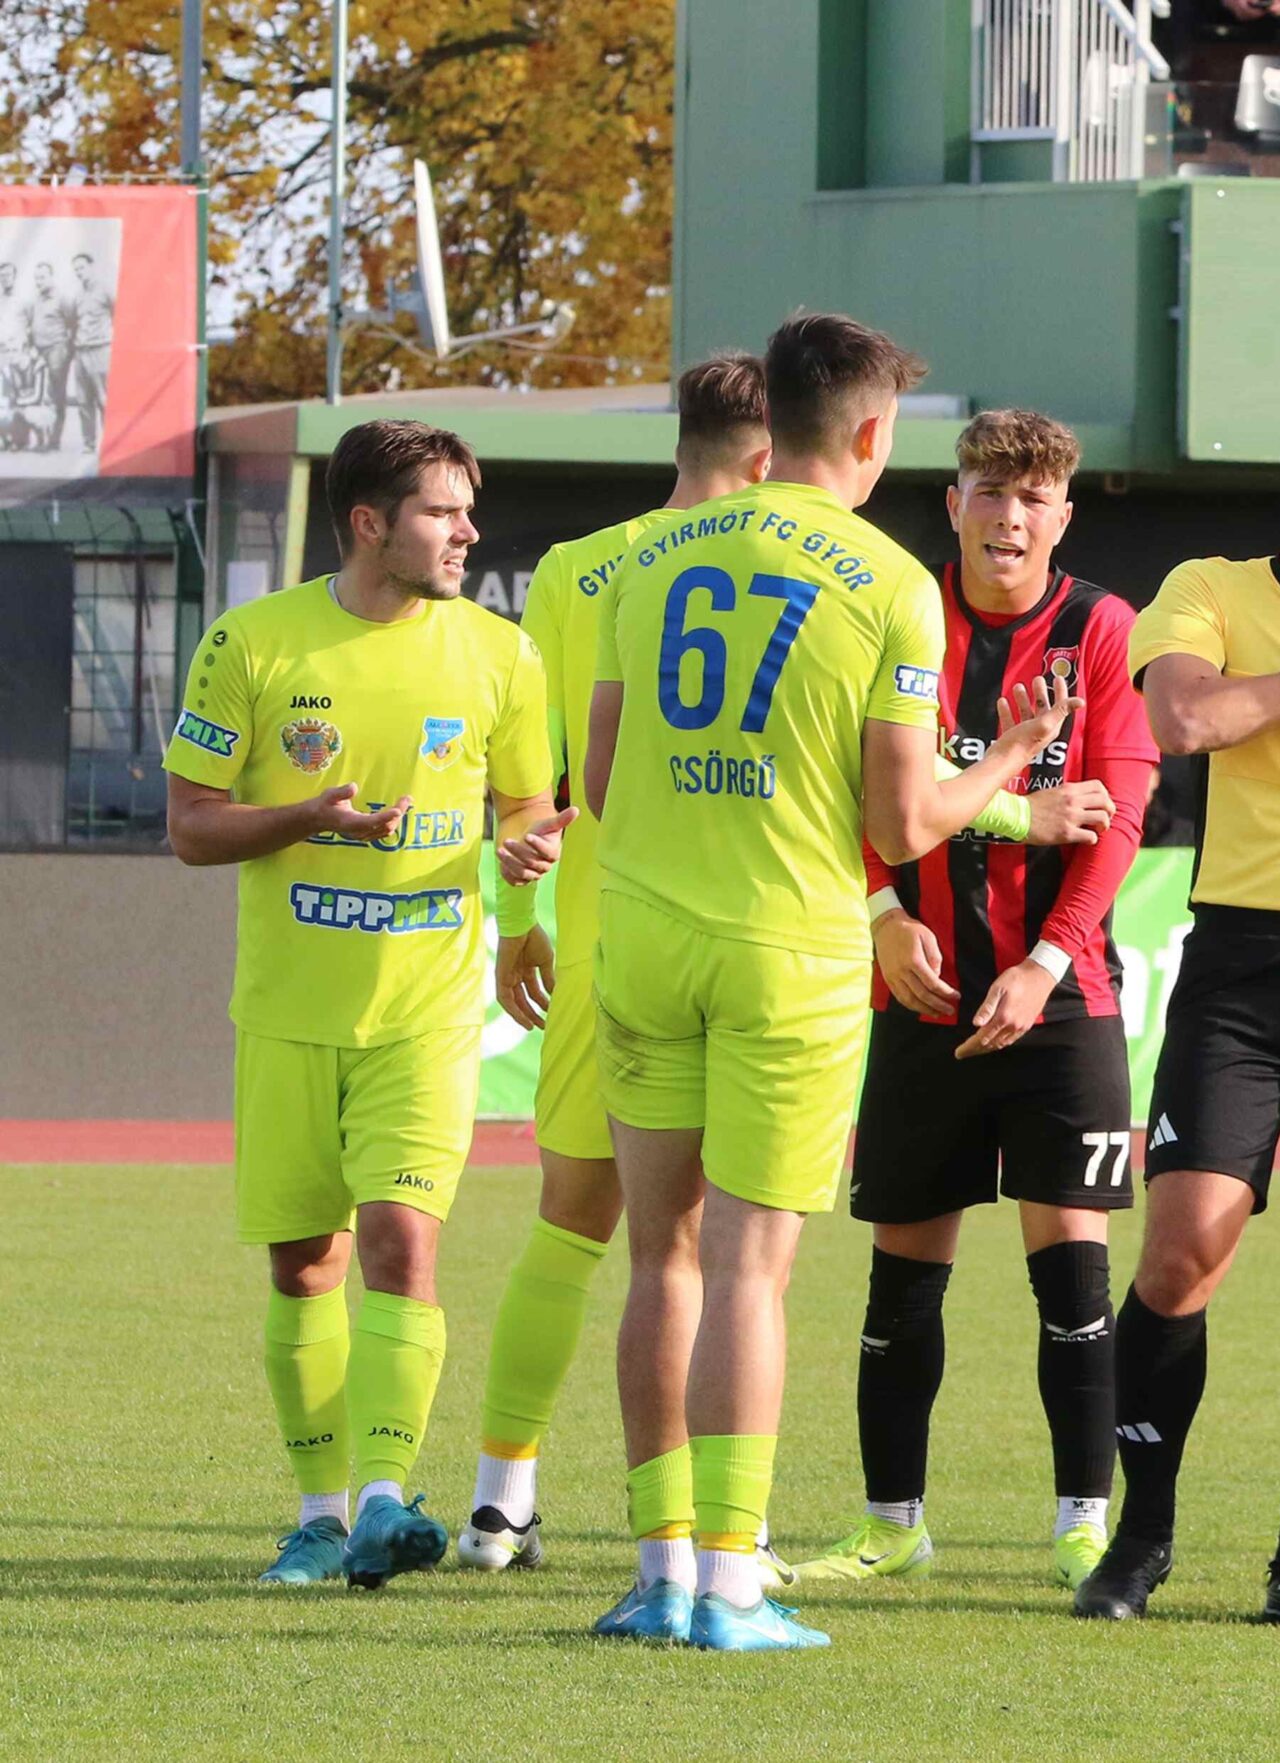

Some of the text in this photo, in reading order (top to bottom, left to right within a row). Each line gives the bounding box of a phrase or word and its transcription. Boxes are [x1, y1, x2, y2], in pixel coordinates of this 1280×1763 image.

[638, 510, 875, 592] GYIRMÓT FC GYŐR
[658, 566, 821, 733] 67
[289, 696, 332, 709] JAKO
[670, 751, 776, 799] CSÖRGŐ
[394, 1172, 435, 1192] JAKO
[1082, 1131, 1130, 1187] 77
[368, 1427, 414, 1444] JAKO
